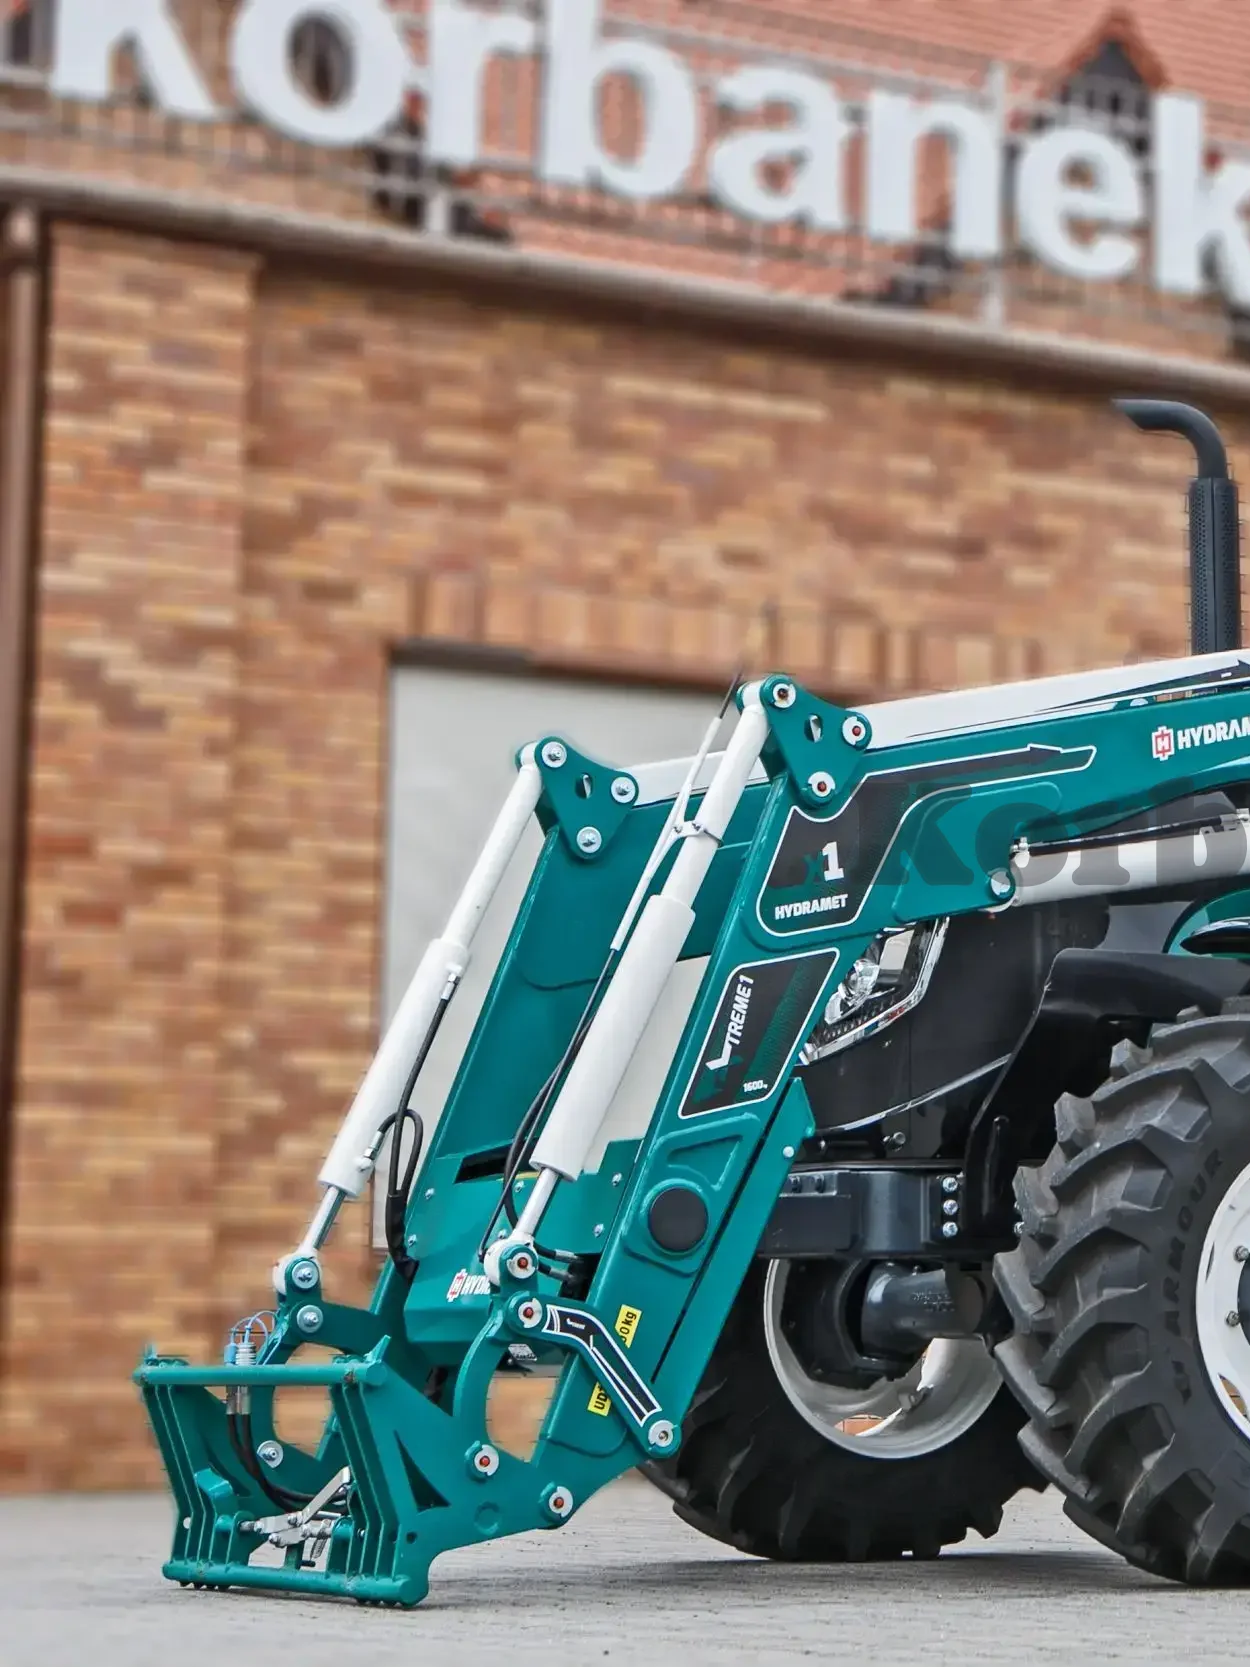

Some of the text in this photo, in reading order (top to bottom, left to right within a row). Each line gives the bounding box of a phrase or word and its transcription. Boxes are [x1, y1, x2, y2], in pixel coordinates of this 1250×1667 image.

[774, 893, 849, 921] HYDRAMET
[1162, 1148, 1223, 1337] ARMOUR
[593, 1384, 609, 1411] UD
[621, 1310, 638, 1327] kg
